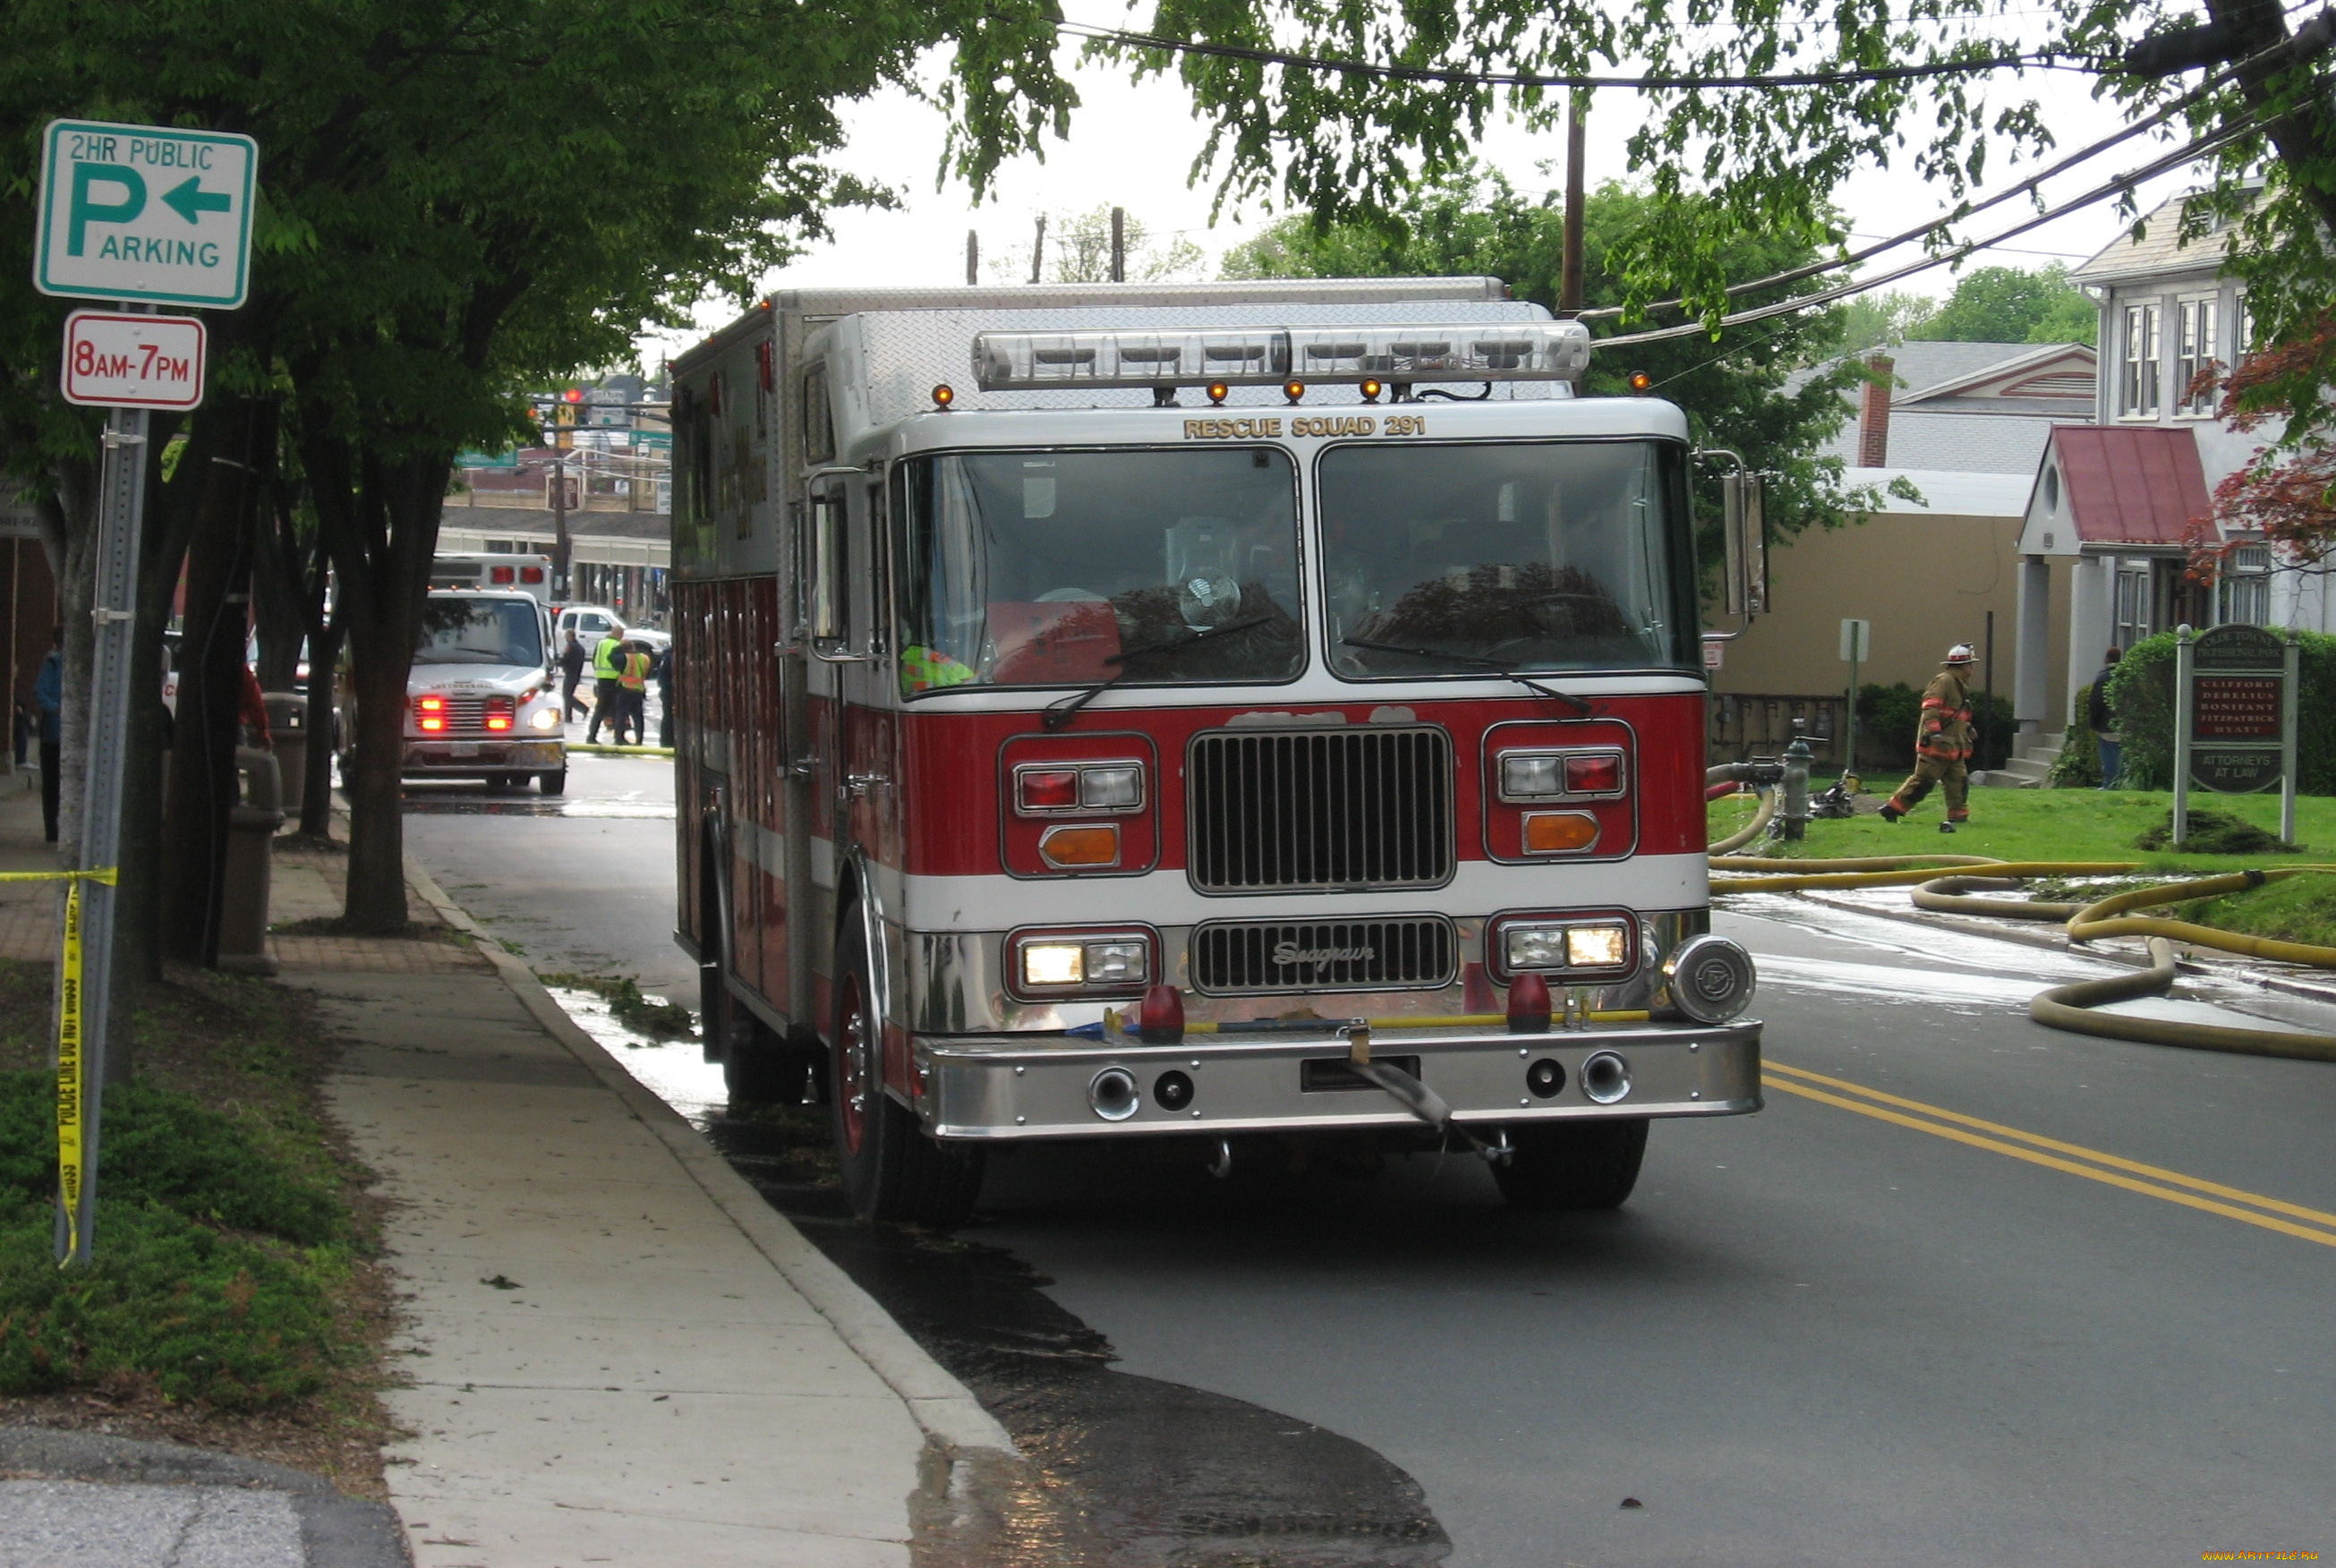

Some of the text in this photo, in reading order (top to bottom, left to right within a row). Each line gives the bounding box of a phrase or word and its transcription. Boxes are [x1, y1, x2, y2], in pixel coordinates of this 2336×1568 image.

[70, 134, 213, 171] 2HR PUBLIC
[75, 340, 190, 383] 8AM-7PM
[1183, 415, 1426, 439] RESCUE SQUAD 291
[2203, 755, 2271, 766] ATTORNEYS
[2214, 767, 2259, 778] AT LAW
[58, 1061, 76, 1085] LINE
[58, 1088, 76, 1126] POLICE
